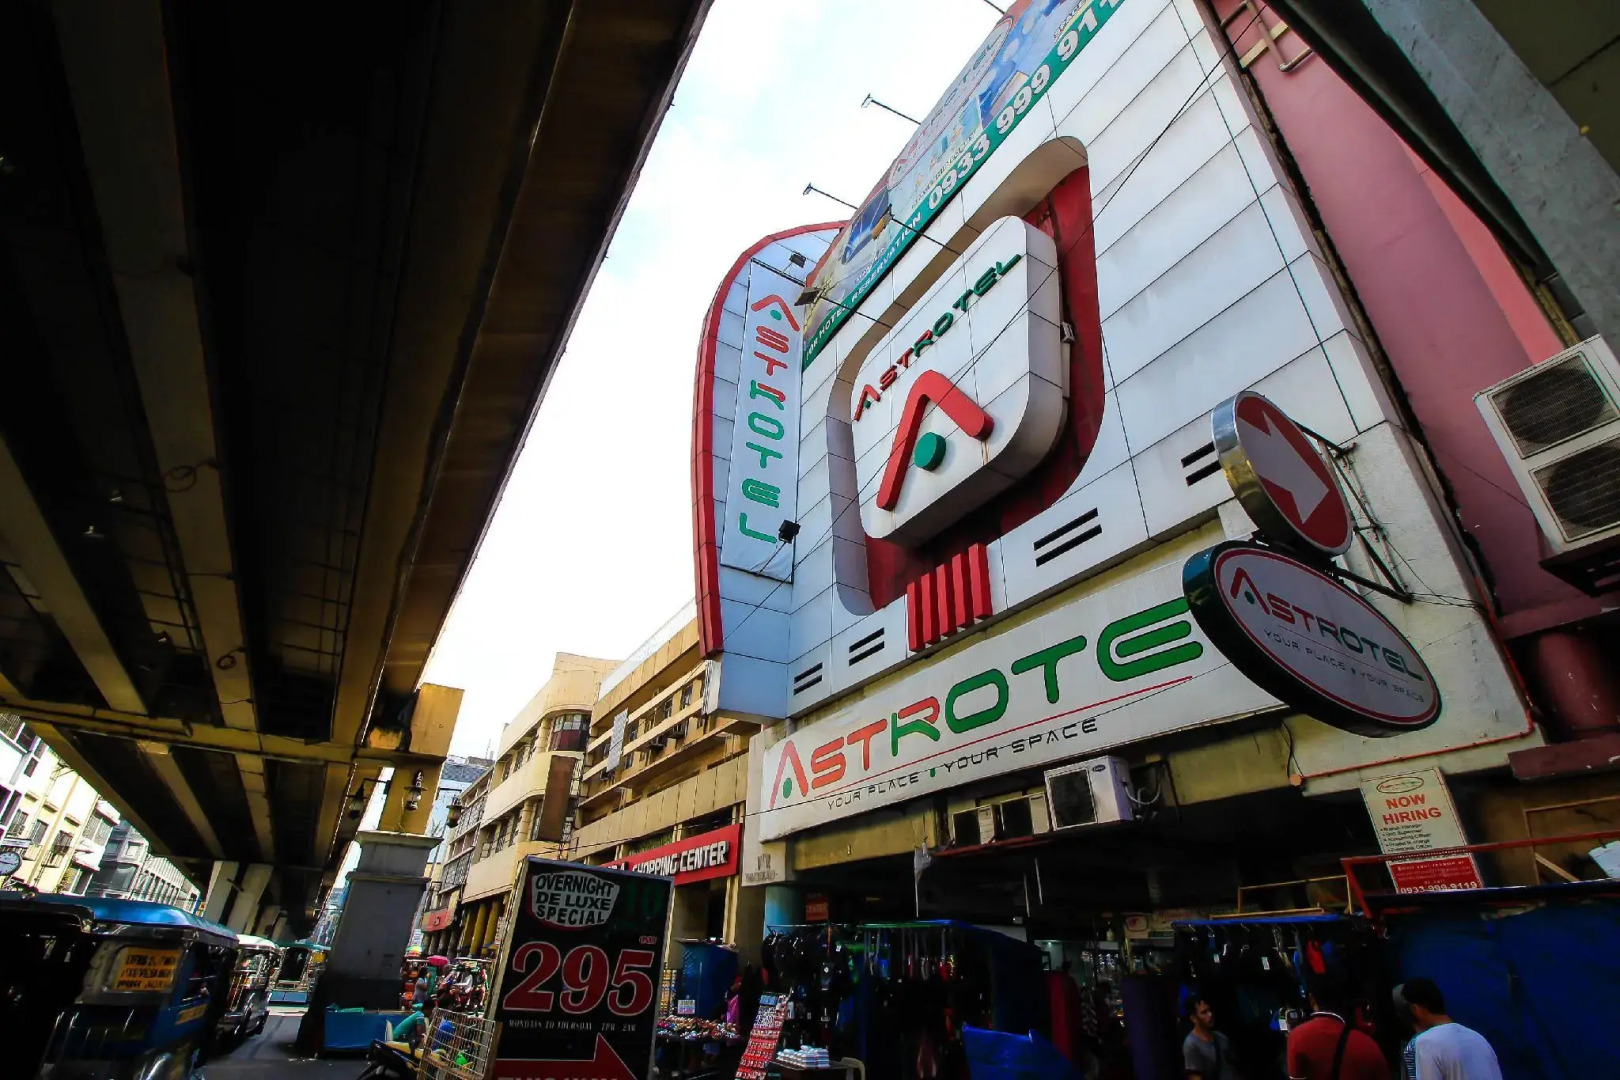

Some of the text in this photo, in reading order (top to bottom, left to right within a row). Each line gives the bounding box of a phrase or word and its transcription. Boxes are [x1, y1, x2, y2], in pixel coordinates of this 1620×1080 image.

[819, 303, 849, 338] HOTEL
[851, 211, 922, 303] RESERVATION
[928, 133, 991, 208] 0933
[996, 64, 1050, 134] 999
[1057, 0, 1121, 61] 91
[854, 253, 1022, 422] ASTROTEL
[739, 294, 801, 544] ASTROTEL
[1230, 567, 1423, 682] ASTROTEL
[1264, 628, 1299, 650] YOUR
[1306, 648, 1347, 671] PLACE
[1359, 671, 1388, 689] YOUR
[769, 596, 1204, 809] ASTROTE
[827, 718, 1099, 810] YOUR PLACE YOUR SPACE
[1382, 807, 1442, 825] HIRING
[1385, 793, 1425, 809] NOW
[535, 874, 615, 898] OVERNIGHT
[680, 840, 730, 872] CENTER
[536, 891, 611, 912] DE LUXE
[536, 904, 605, 926] SPECIAL
[503, 942, 655, 1016] 295
